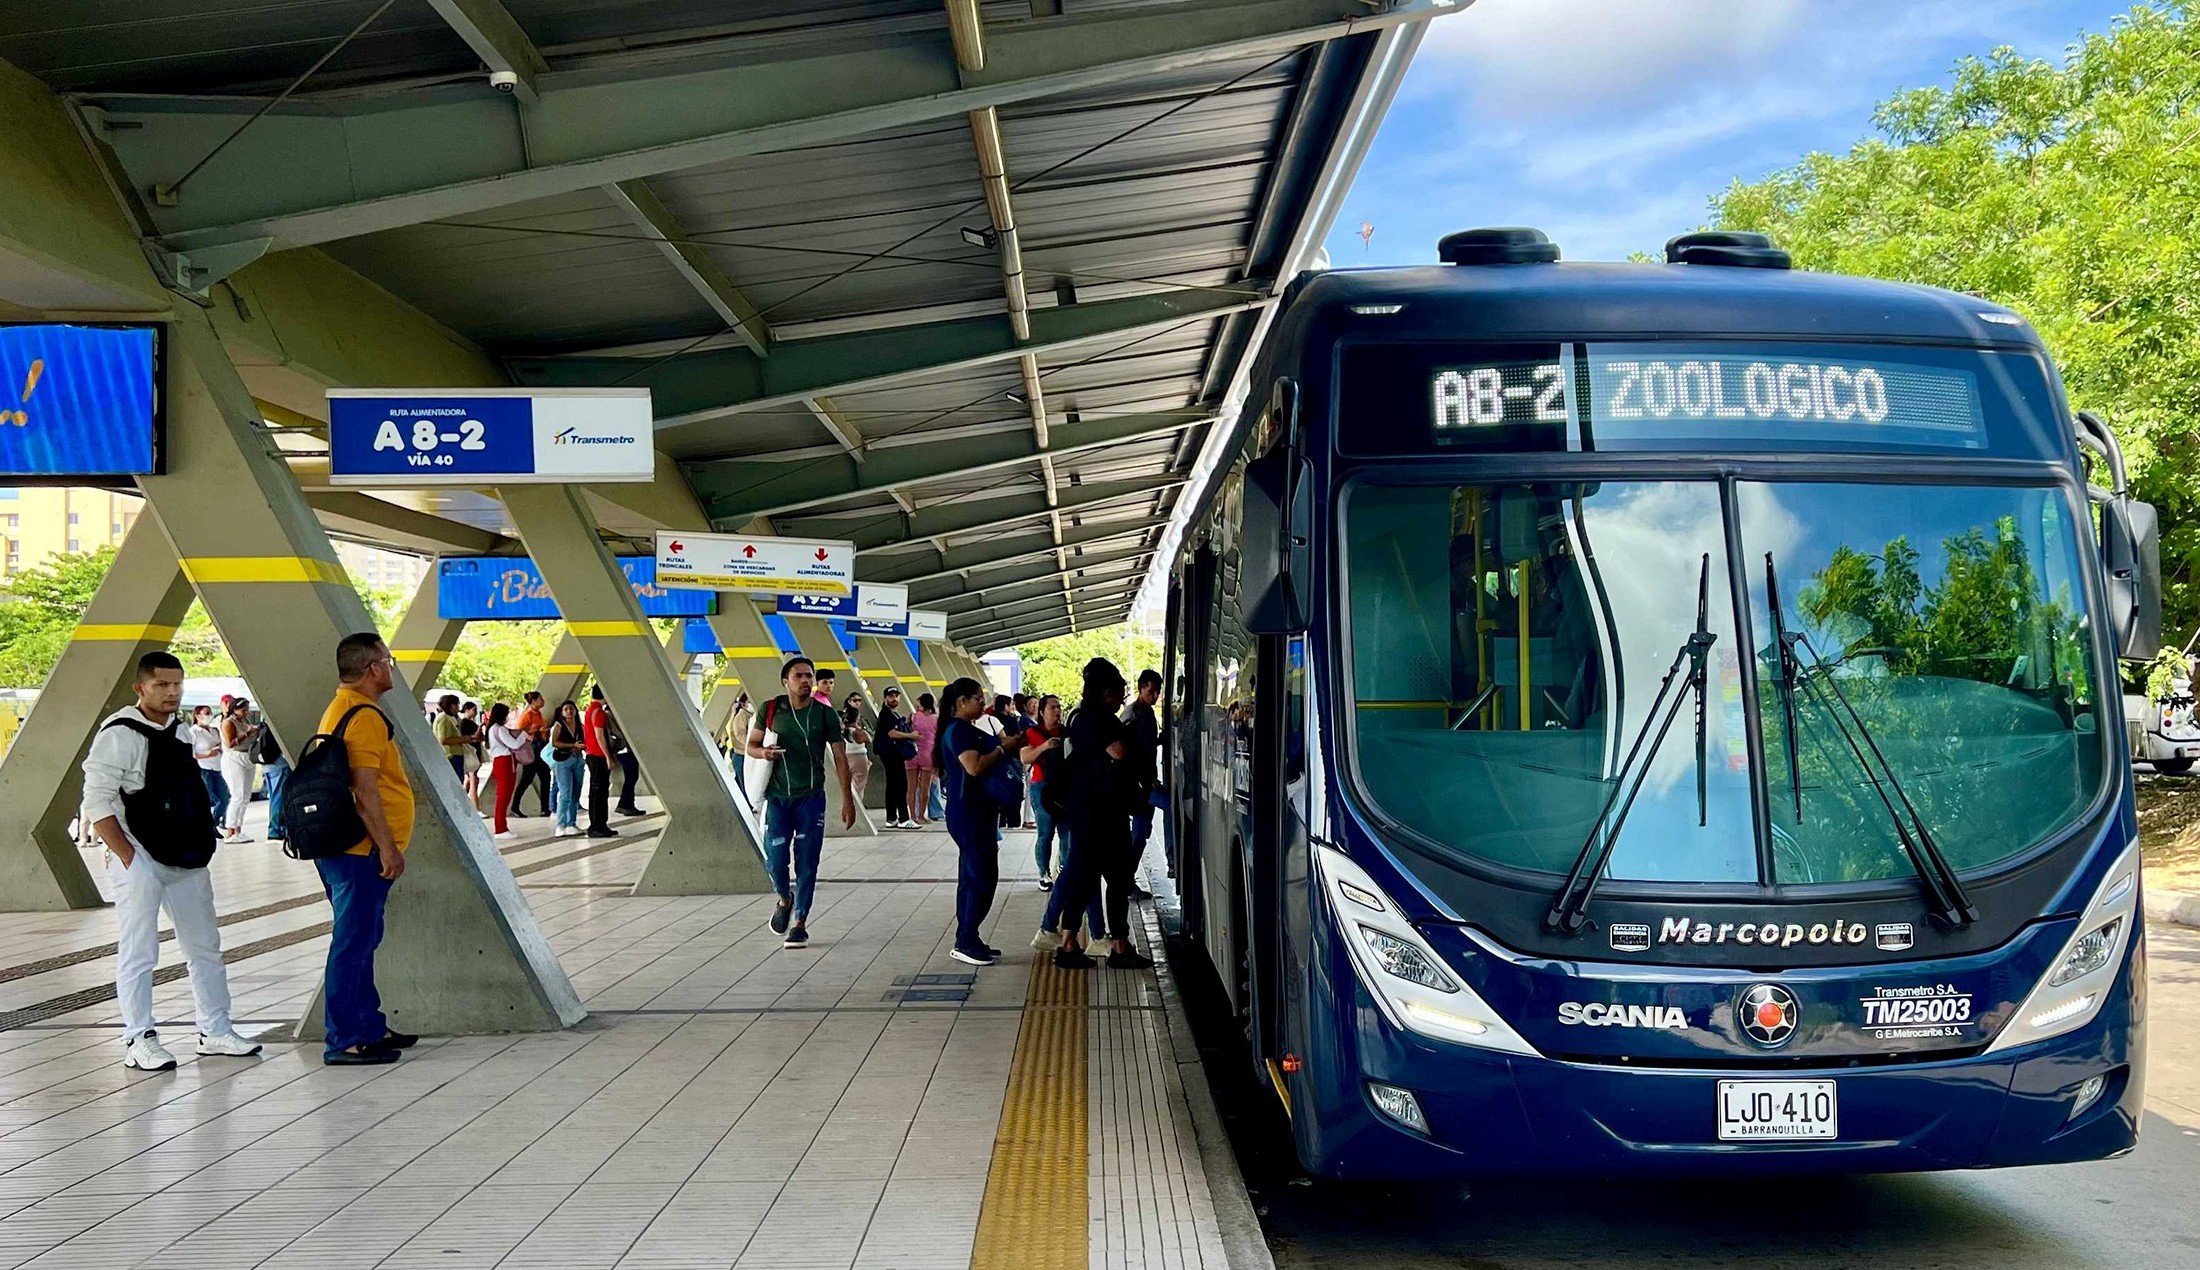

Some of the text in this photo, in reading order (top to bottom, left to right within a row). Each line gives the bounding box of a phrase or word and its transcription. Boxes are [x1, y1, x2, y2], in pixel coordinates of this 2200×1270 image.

[1607, 361, 1888, 422] ZOOLOGICO
[410, 408, 467, 416] ALIMENTADORA
[373, 419, 486, 451] A 8-2
[571, 434, 635, 445] Transmetro
[408, 451, 453, 466] VÍA 40
[1658, 916, 1867, 948] Marcopolo
[1874, 984, 1958, 997] Transmetro S.A.
[1558, 1001, 1688, 1029] SCANIA
[1862, 998, 1971, 1024] TM25003
[1724, 1092, 1830, 1123] LJO 410
[1741, 1125, 1814, 1135] BARRANQUILLA
